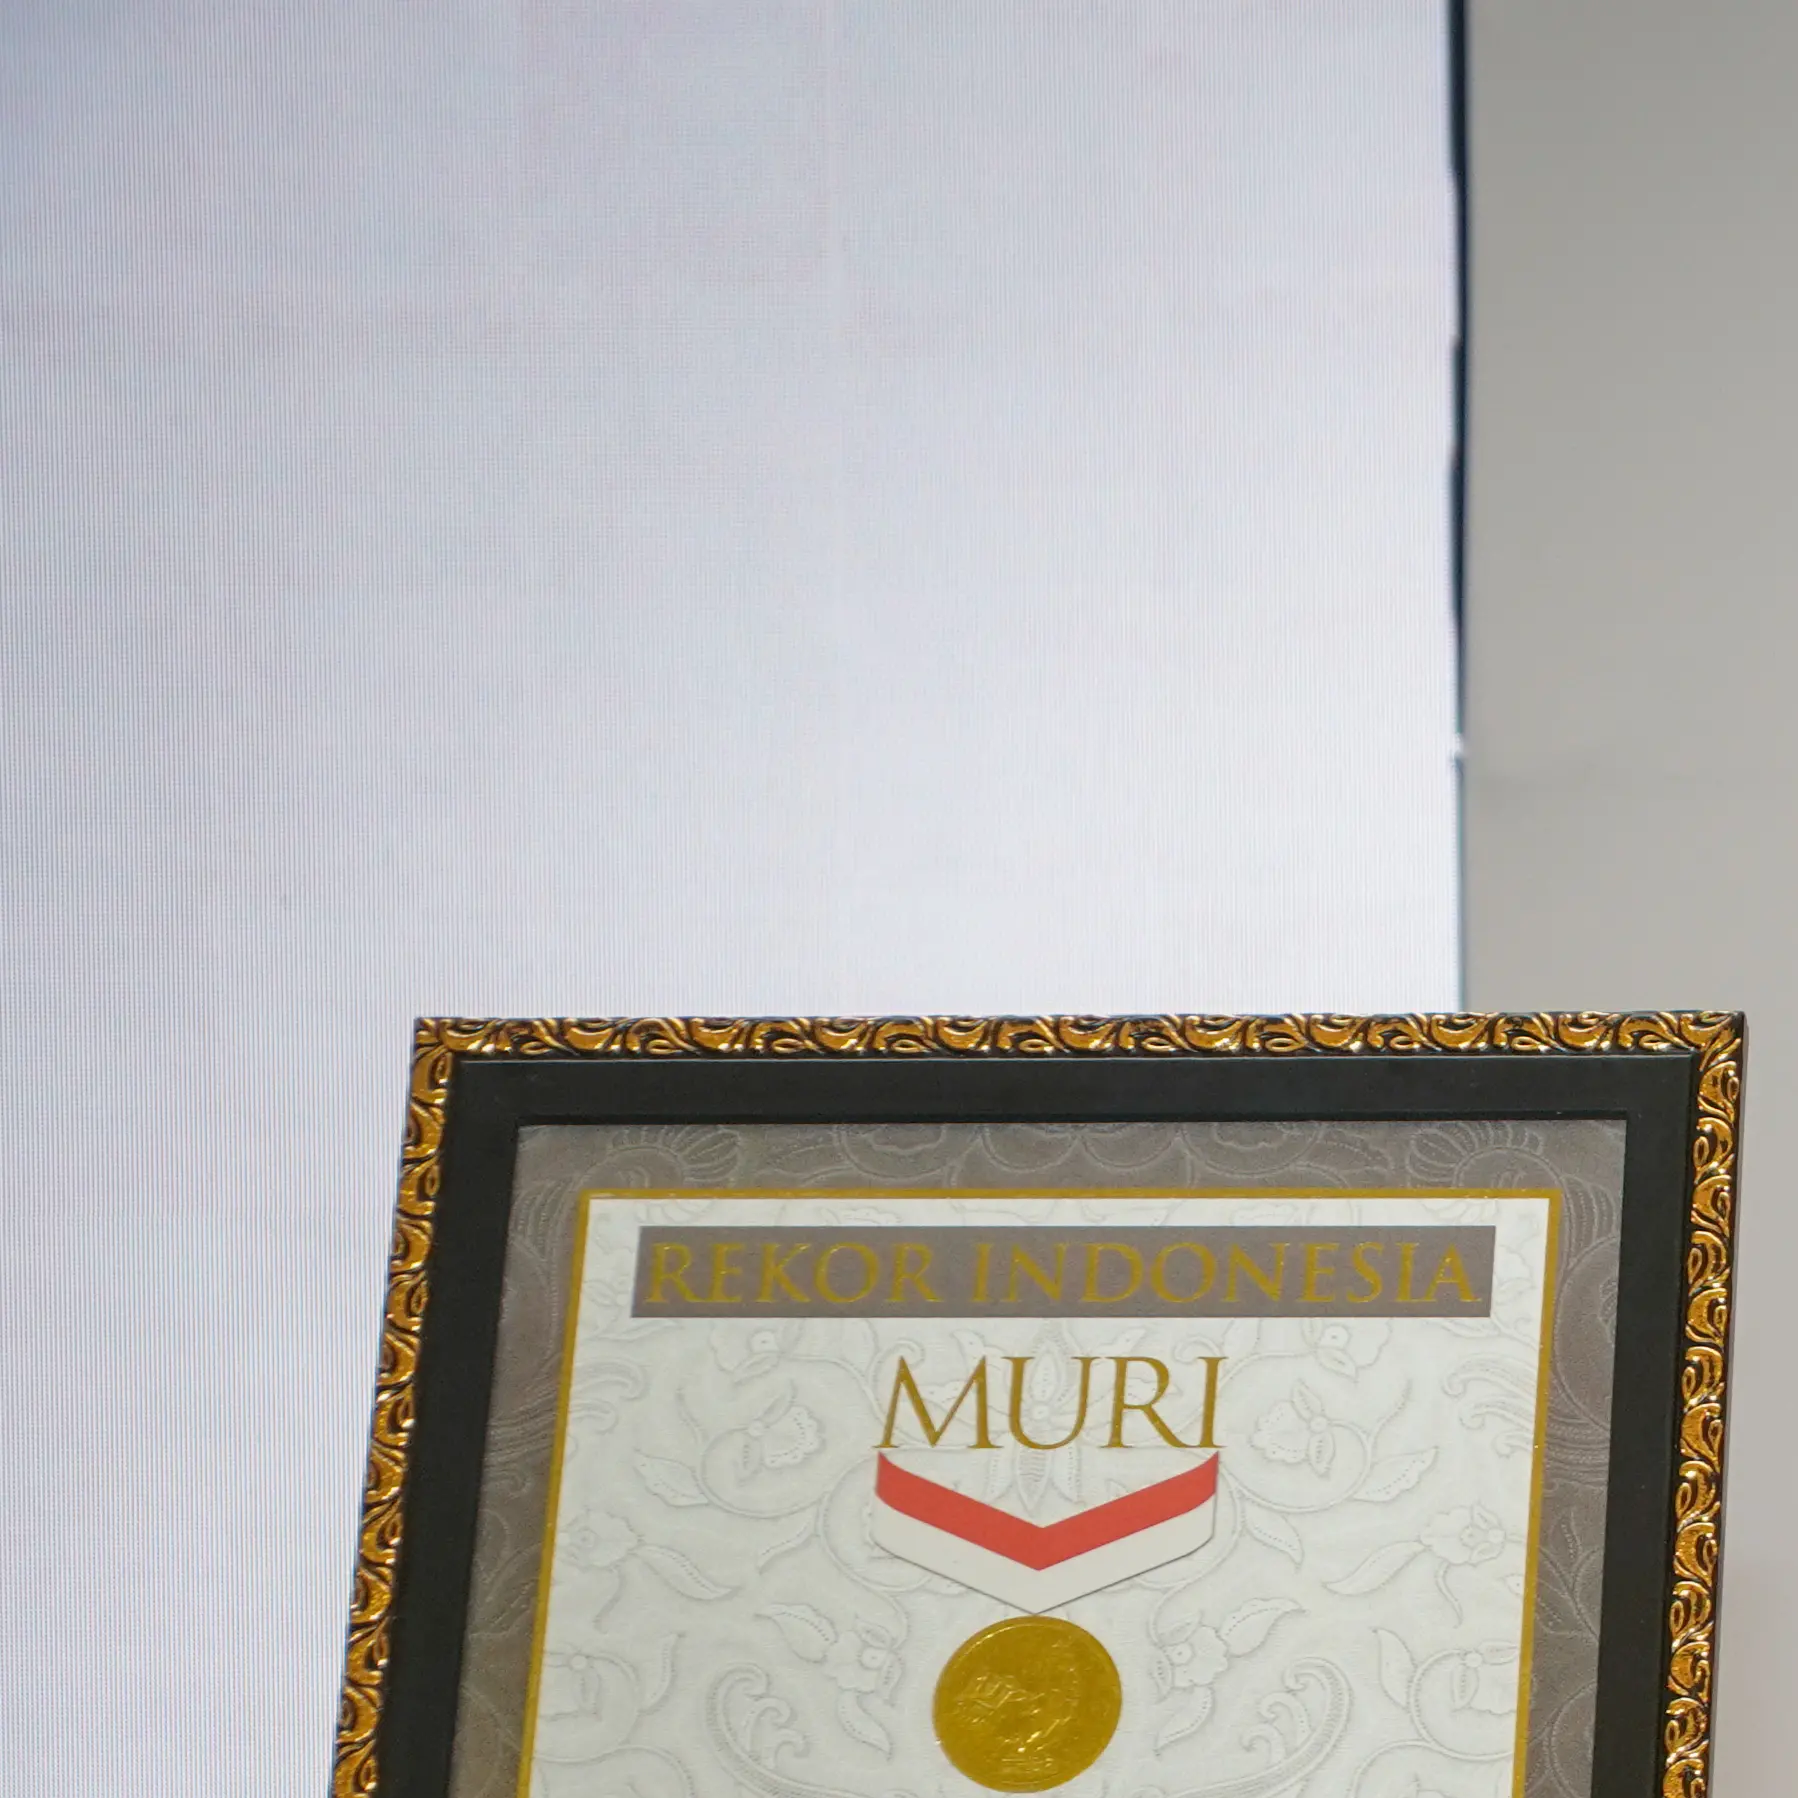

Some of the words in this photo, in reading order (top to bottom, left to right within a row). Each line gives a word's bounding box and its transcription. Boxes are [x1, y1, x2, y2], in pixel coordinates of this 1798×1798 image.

[646, 1241, 943, 1304] REKOR
[970, 1241, 1480, 1304] INDONESIA
[877, 1356, 1224, 1451] MURI
